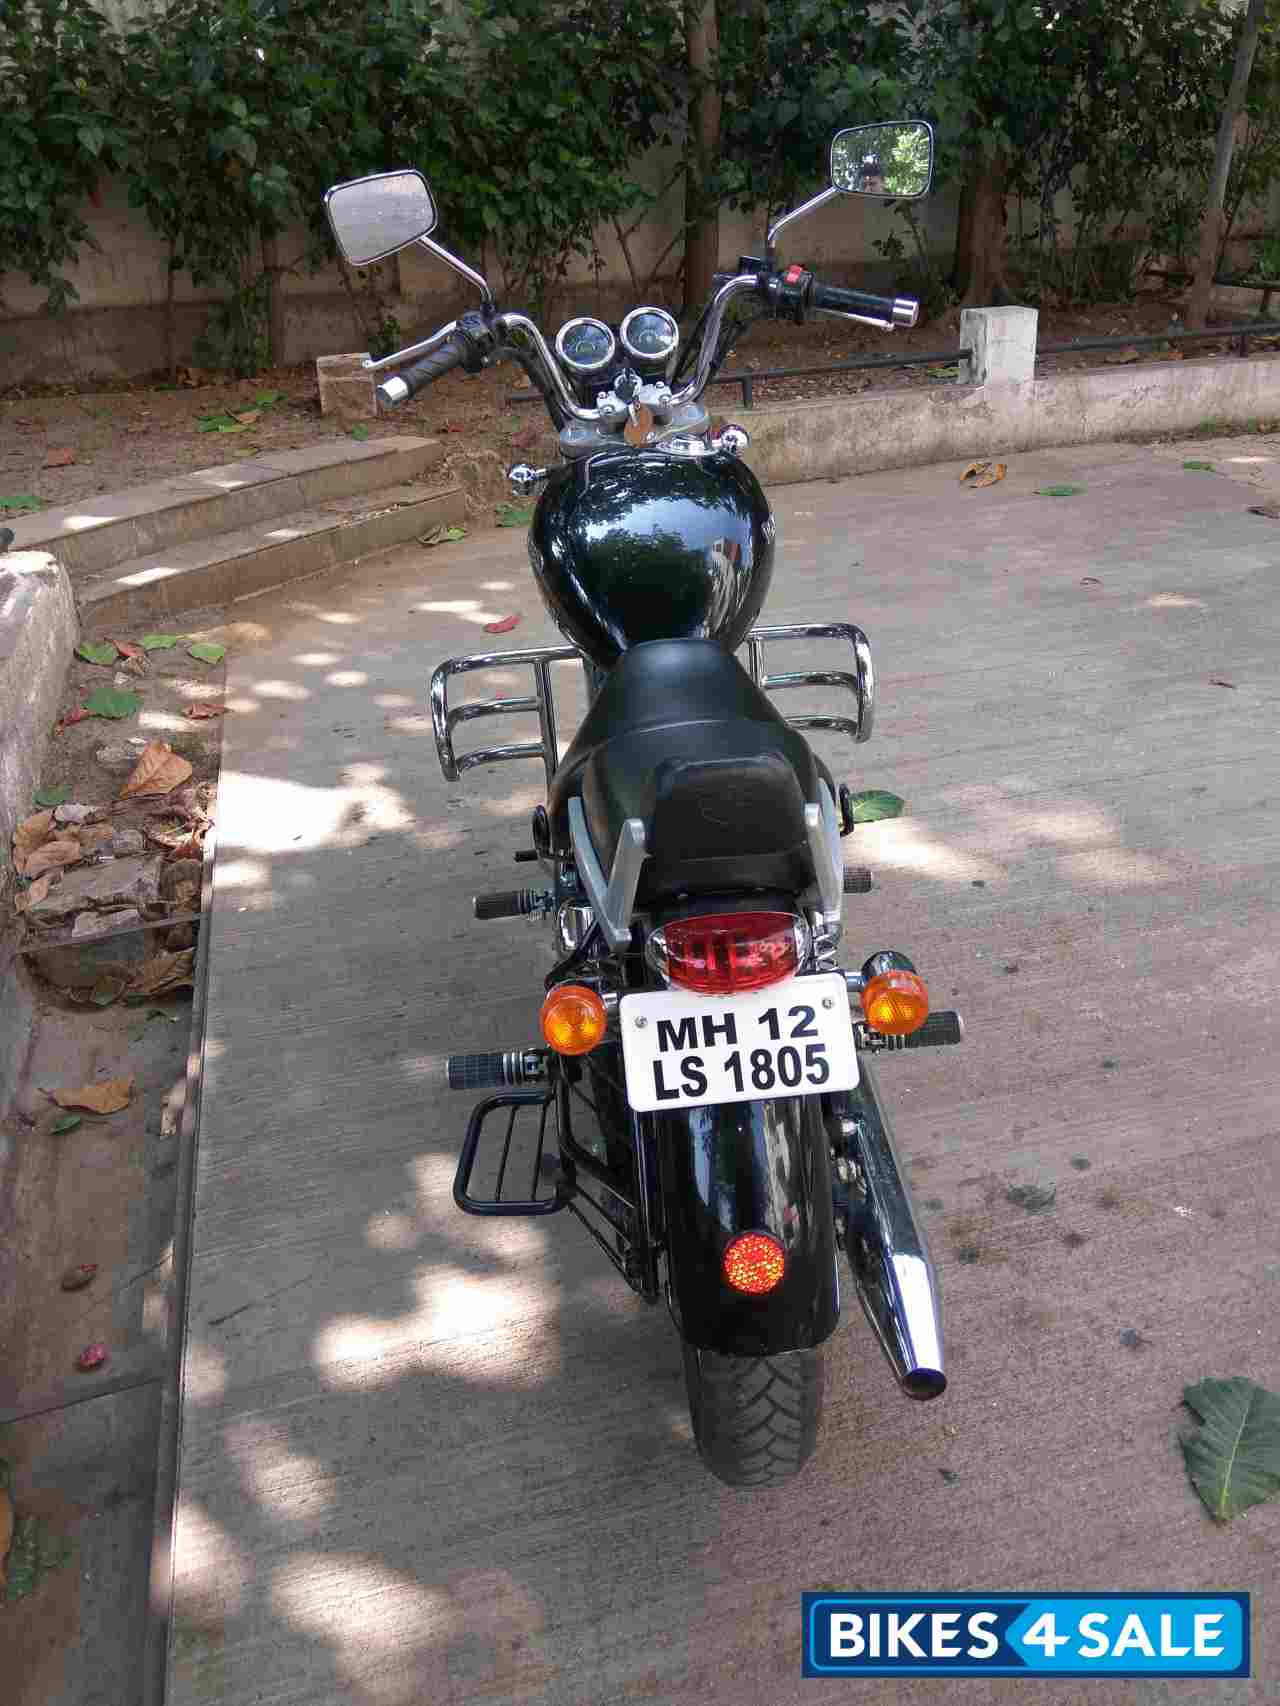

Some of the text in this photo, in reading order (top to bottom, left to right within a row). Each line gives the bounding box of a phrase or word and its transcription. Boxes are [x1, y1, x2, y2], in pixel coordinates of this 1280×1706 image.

[656, 1005, 819, 1052] MH 12
[652, 1043, 830, 1101] LS 1805
